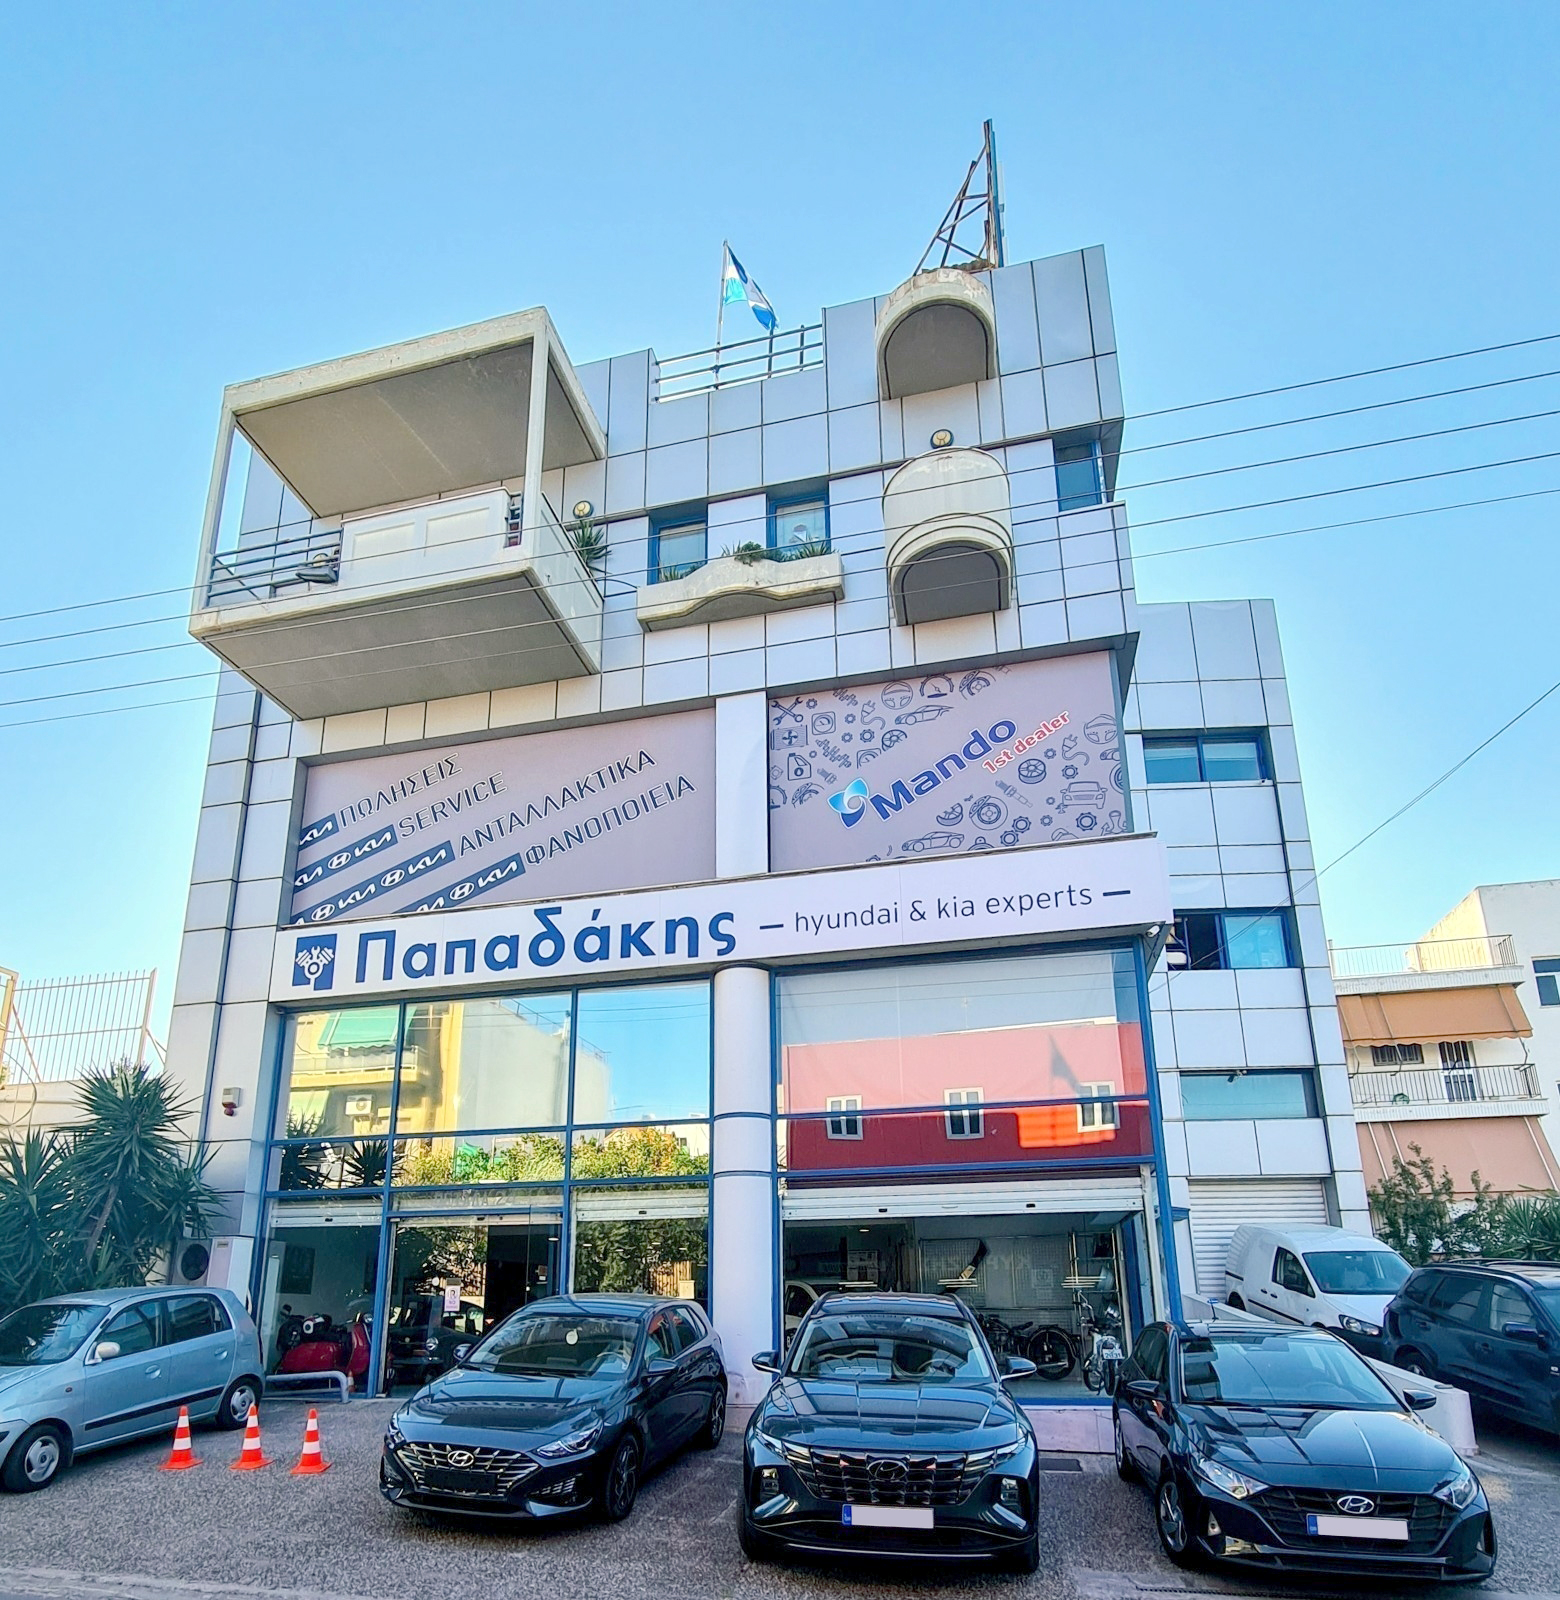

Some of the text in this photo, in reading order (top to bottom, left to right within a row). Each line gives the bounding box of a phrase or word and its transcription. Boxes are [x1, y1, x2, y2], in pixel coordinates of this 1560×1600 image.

[868, 719, 1017, 821] Mando
[983, 711, 1069, 773] 1st dealer
[340, 753, 461, 828] ΠΩΛΗΣΕΙΣ
[398, 772, 506, 838] SERVICE
[460, 749, 656, 857] ΑΝΤΑΛΛΑΚΤΙΚΑ
[525, 774, 696, 866] ΦΑΝΟΠΟΙΕΙΑ
[355, 906, 736, 983] Παπαδάκης
[794, 883, 1093, 936] hyundai & kia experts
